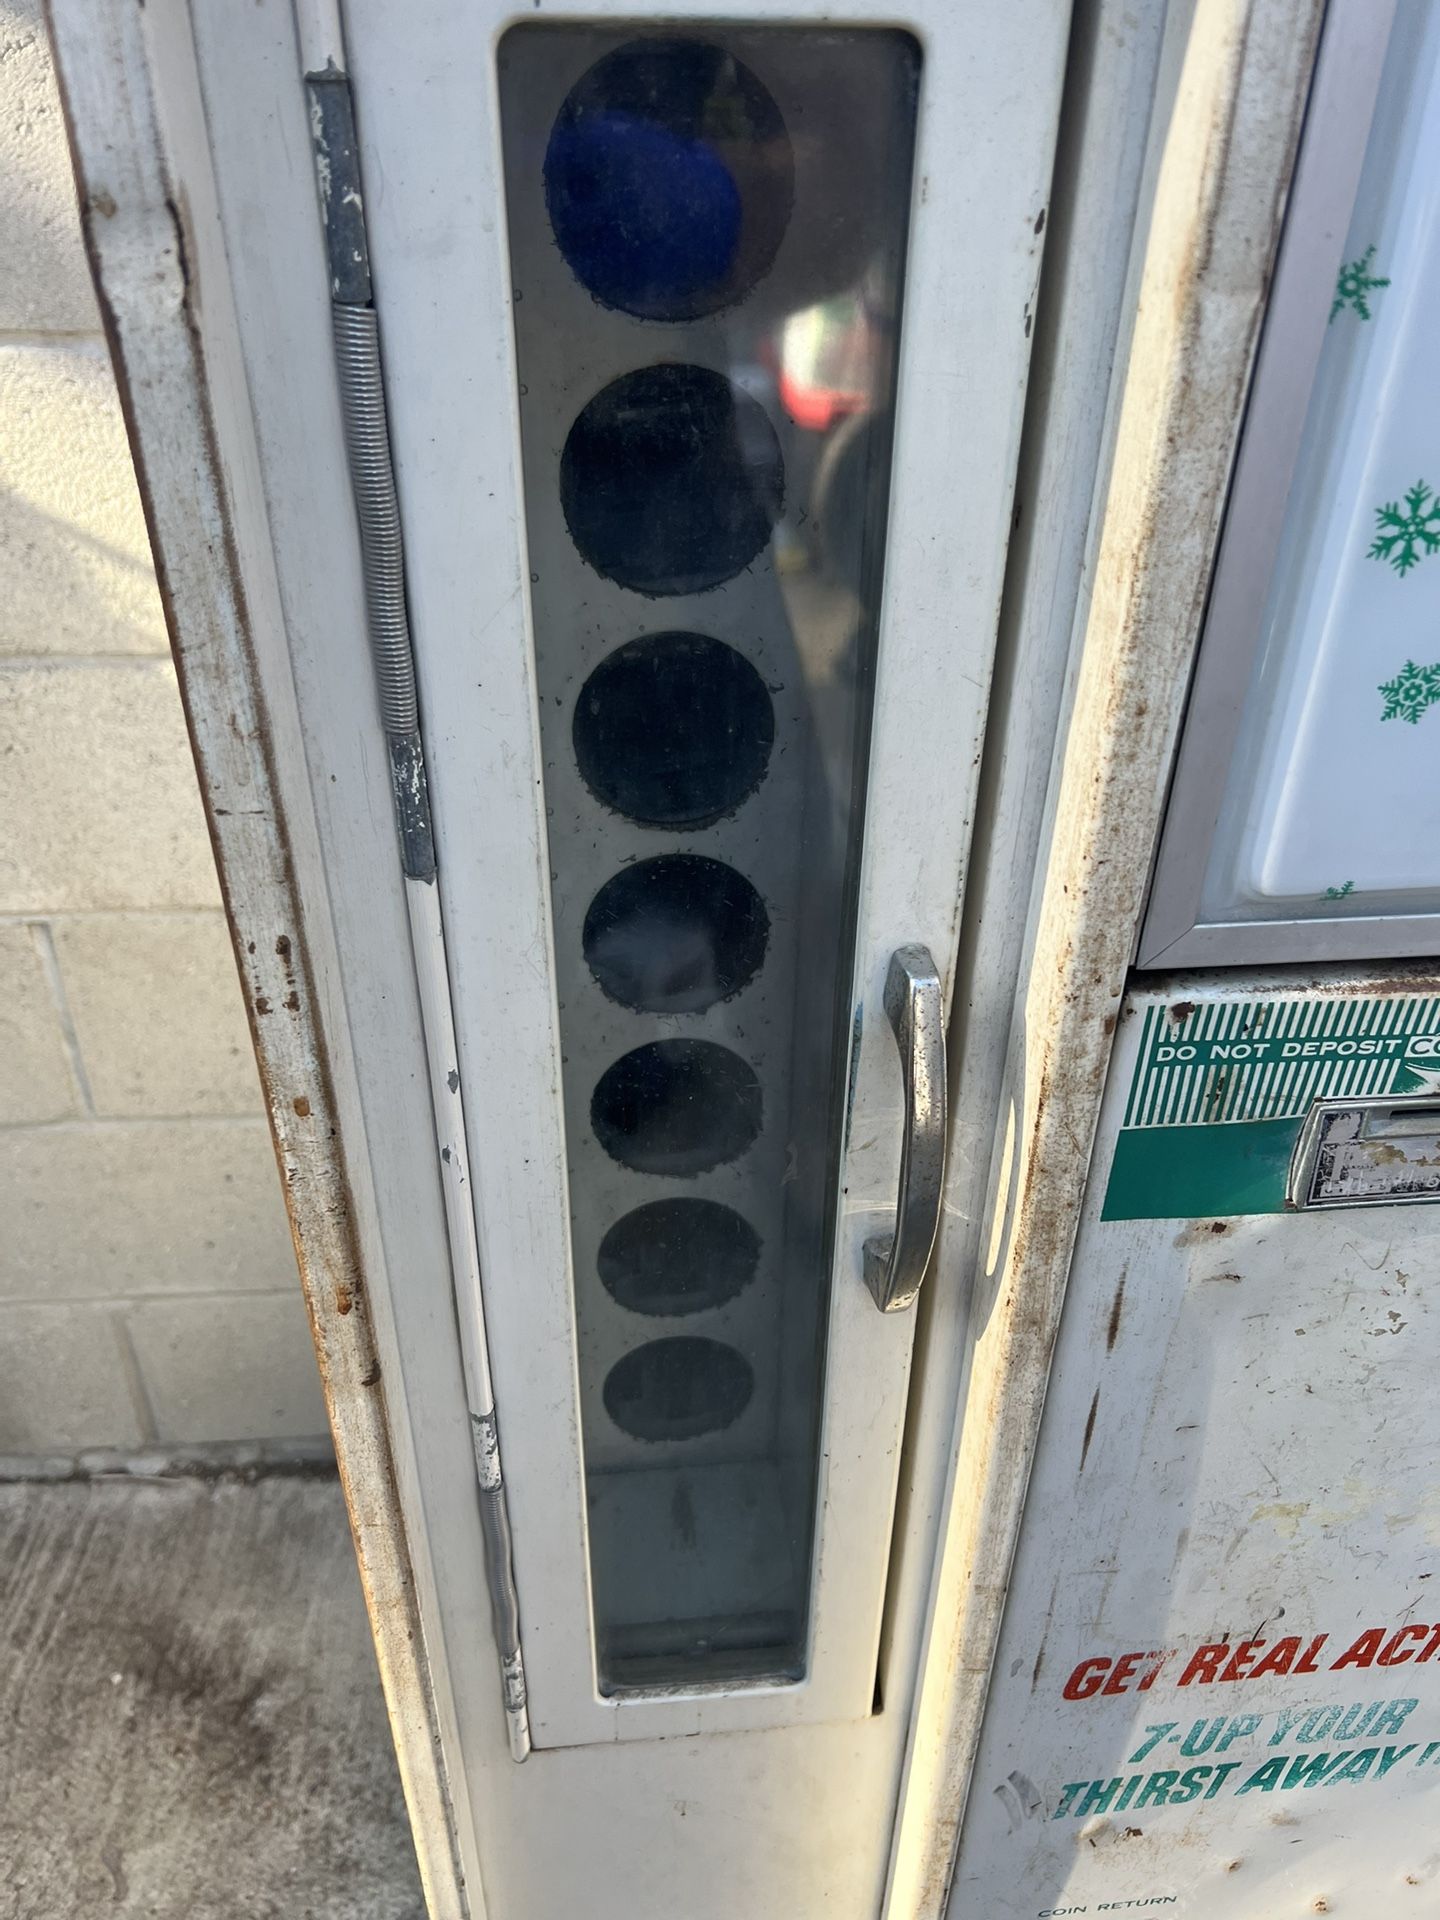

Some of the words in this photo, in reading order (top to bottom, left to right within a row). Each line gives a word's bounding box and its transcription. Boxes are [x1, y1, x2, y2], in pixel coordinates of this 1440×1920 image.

[1156, 1045, 1197, 1062] DO
[1209, 1043, 1270, 1060] NOT
[1280, 1038, 1403, 1058] DEPOSIT
[1062, 1647, 1178, 1700] GET
[1177, 1634, 1330, 1687] REAL
[1128, 1714, 1262, 1763] 7-UP
[1267, 1698, 1420, 1747] YOUR
[1051, 1762, 1242, 1820] THIRST
[1038, 1906, 1087, 1918] COIN
[1097, 1896, 1177, 1911] RETURN
